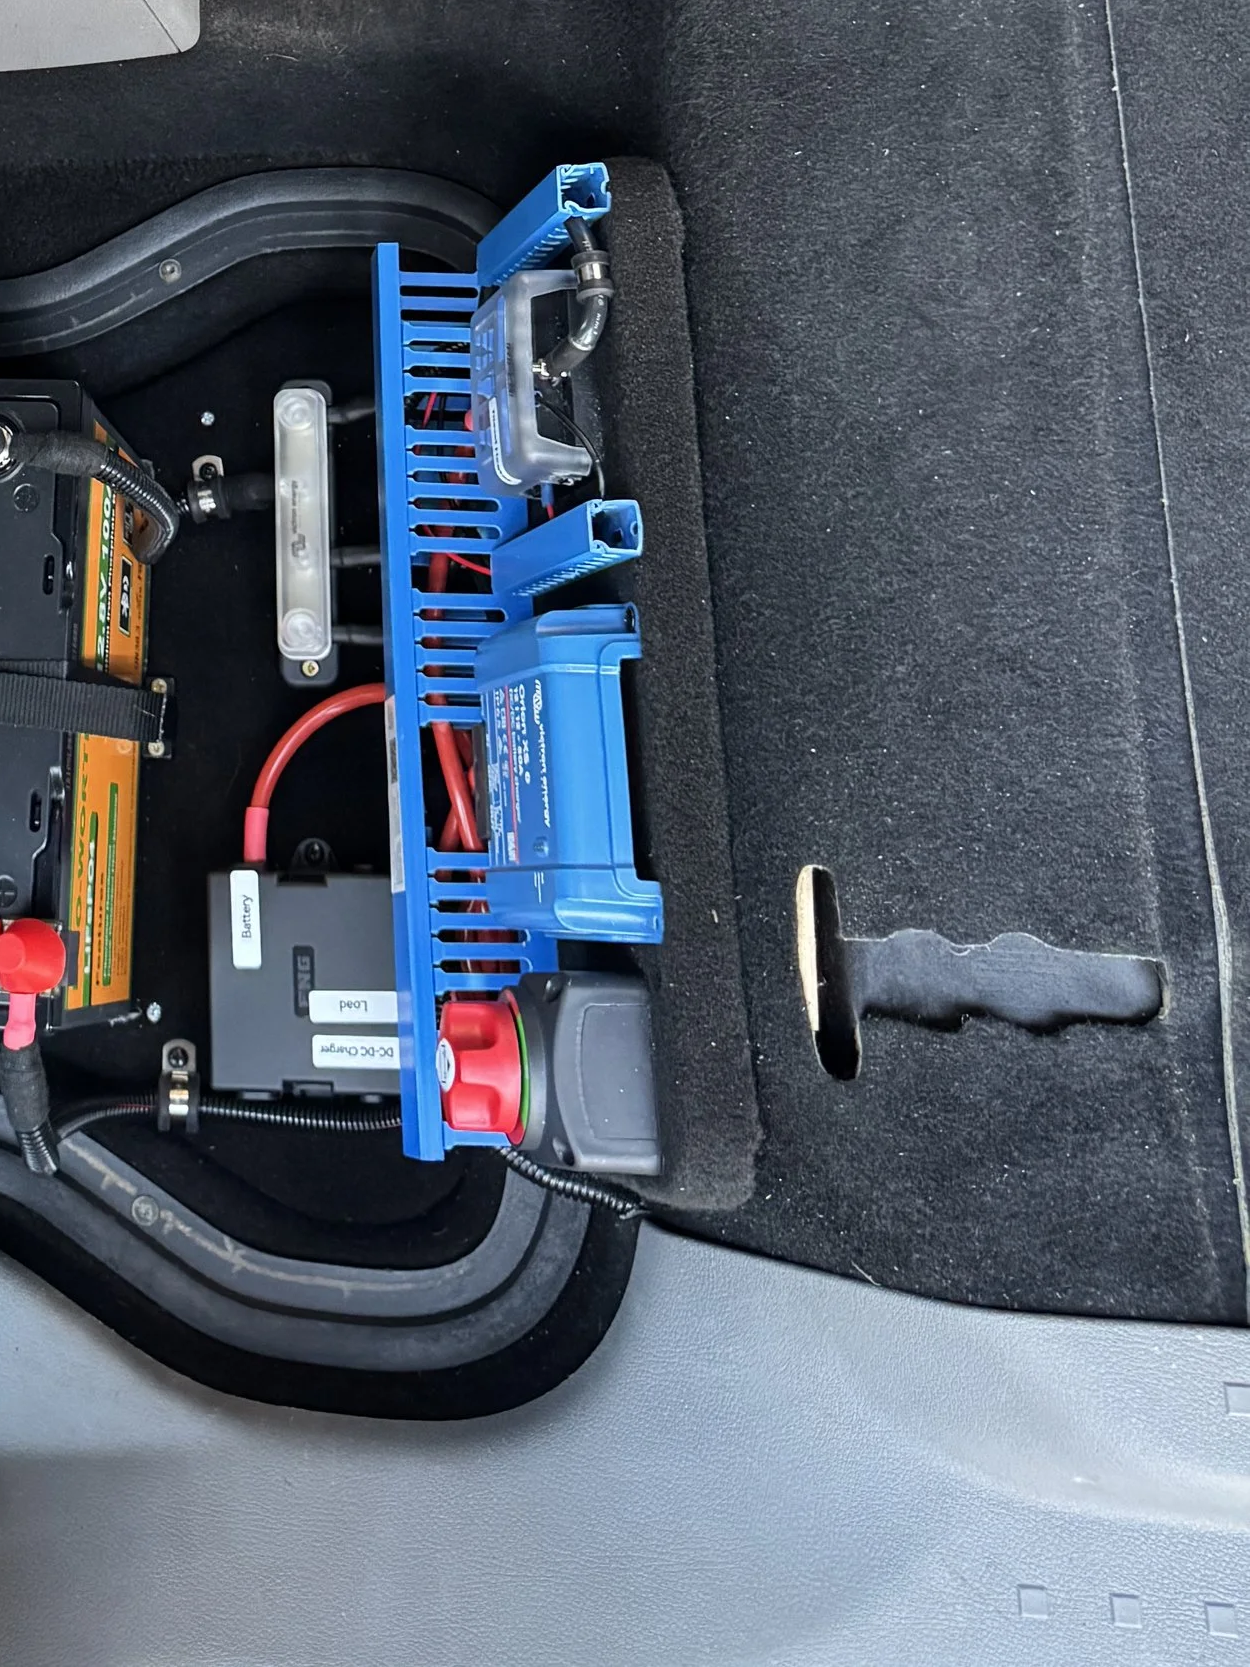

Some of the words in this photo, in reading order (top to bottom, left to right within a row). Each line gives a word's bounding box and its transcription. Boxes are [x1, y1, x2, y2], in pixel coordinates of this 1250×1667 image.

[519, 684, 527, 735] Orion
[522, 739, 529, 765] XS
[241, 894, 254, 939] Battery
[339, 999, 368, 1013] Load
[320, 1042, 358, 1057] Charger
[360, 1046, 394, 1058] DC-DC
